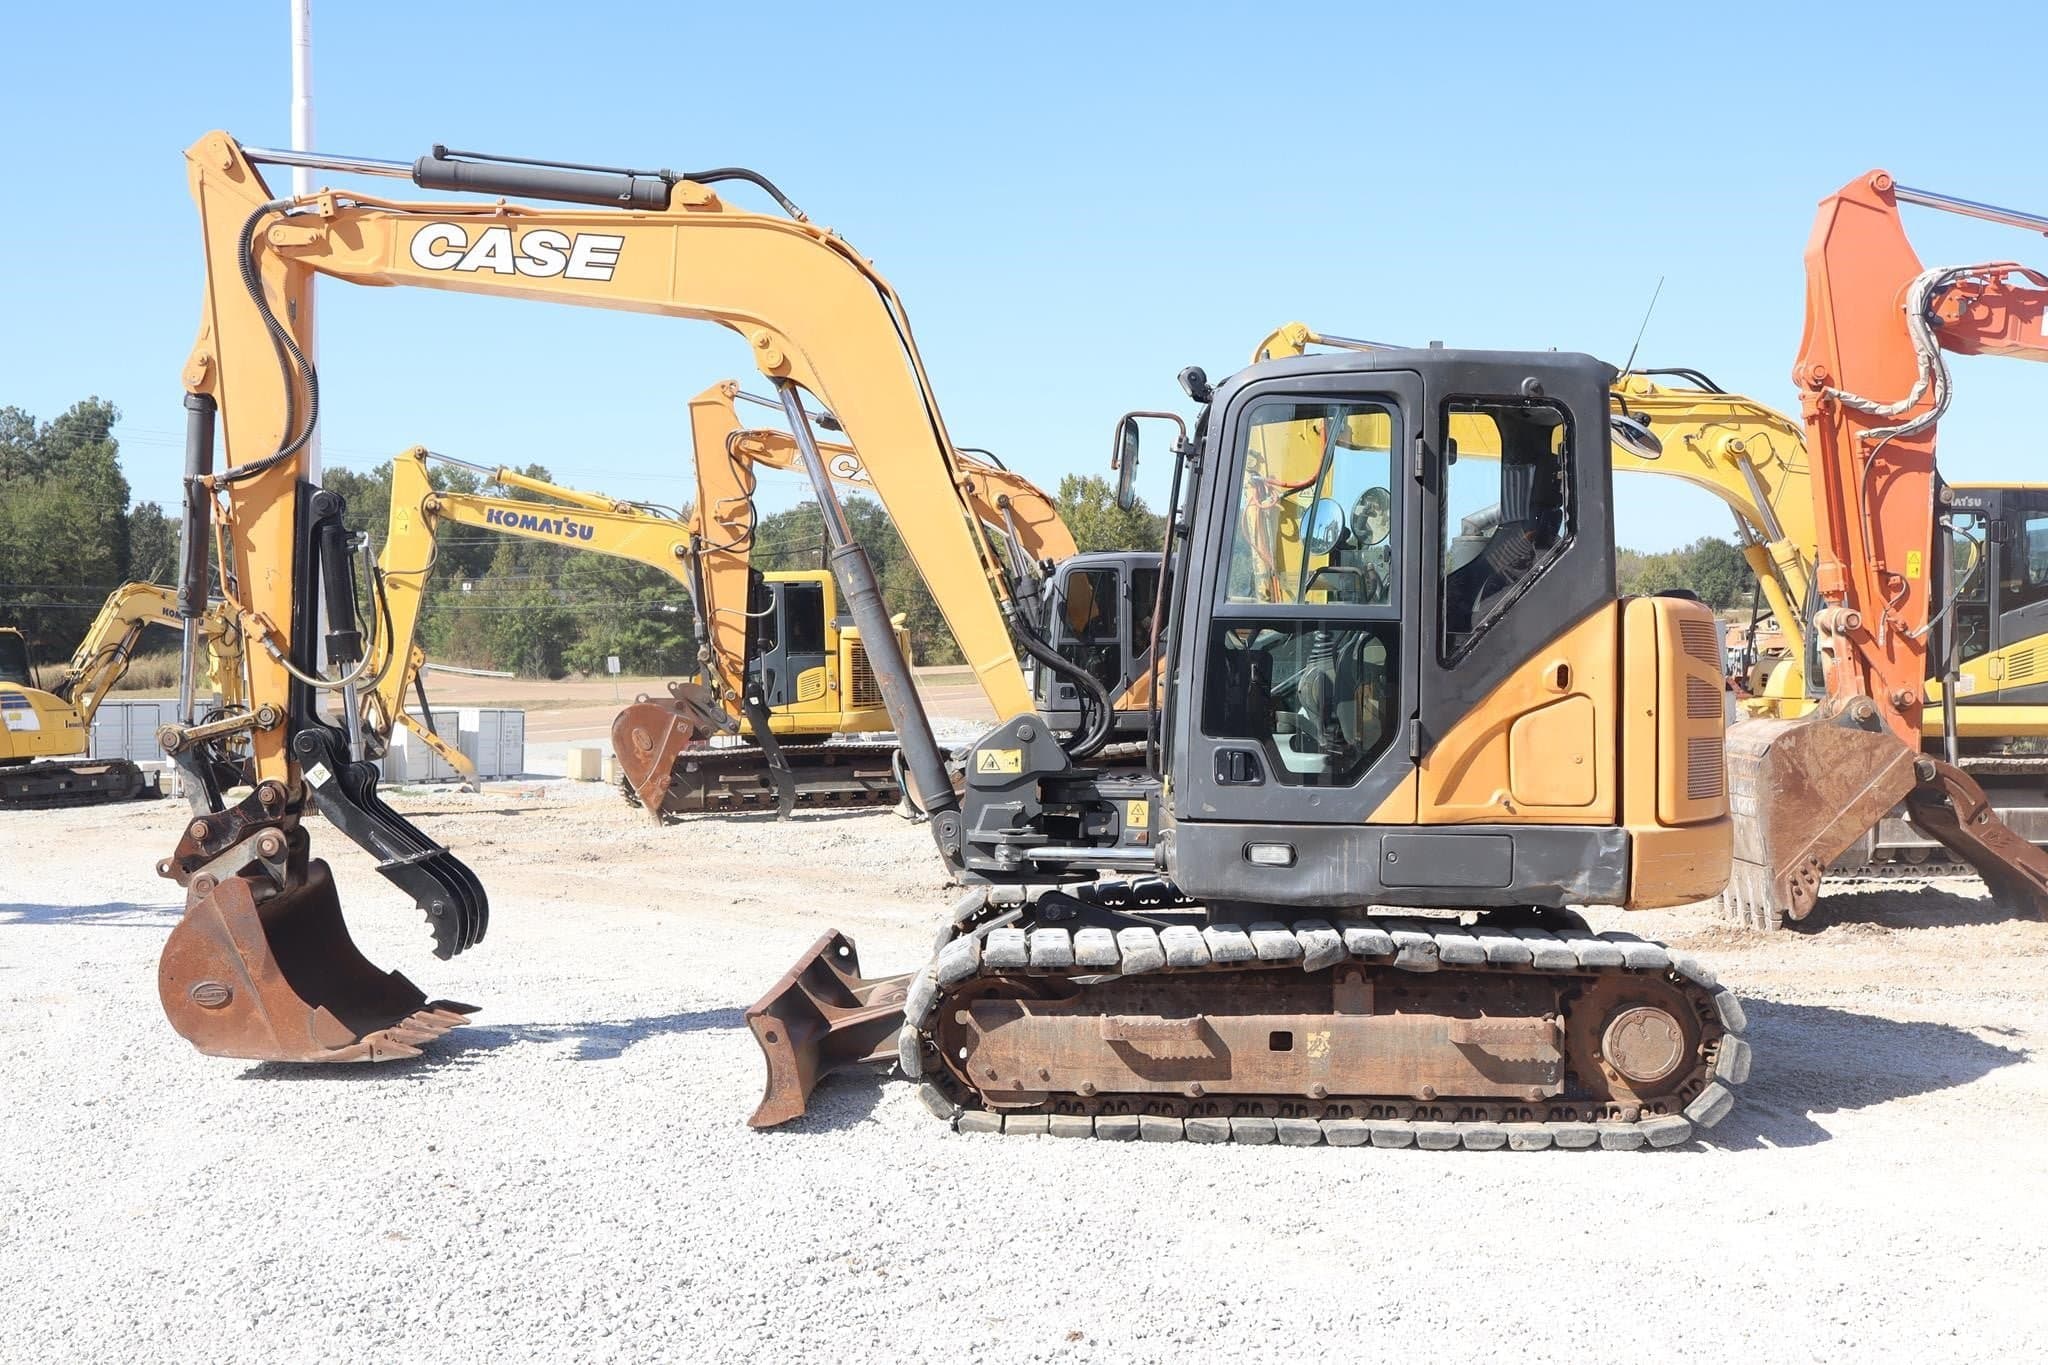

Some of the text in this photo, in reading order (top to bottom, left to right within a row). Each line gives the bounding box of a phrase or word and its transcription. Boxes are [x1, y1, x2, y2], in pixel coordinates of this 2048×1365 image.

[410, 222, 625, 281] CASE
[1951, 496, 1982, 507] ATSU
[486, 508, 594, 541] KOMATSU
